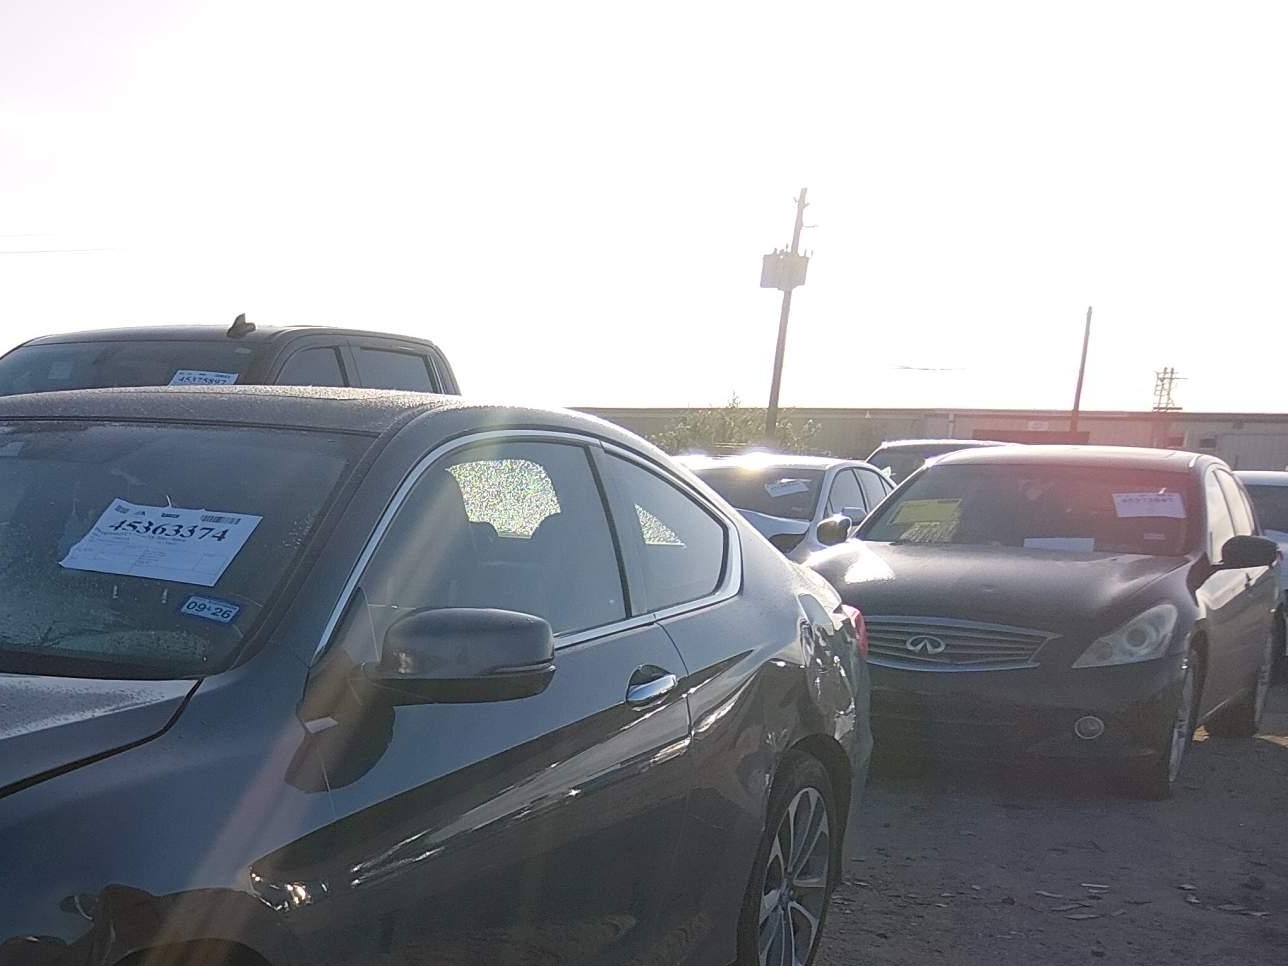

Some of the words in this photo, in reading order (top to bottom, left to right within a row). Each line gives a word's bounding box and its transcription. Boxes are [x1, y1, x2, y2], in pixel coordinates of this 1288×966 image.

[108, 519, 230, 542] 45363374
[186, 601, 207, 612] 09
[210, 607, 233, 619] 26
